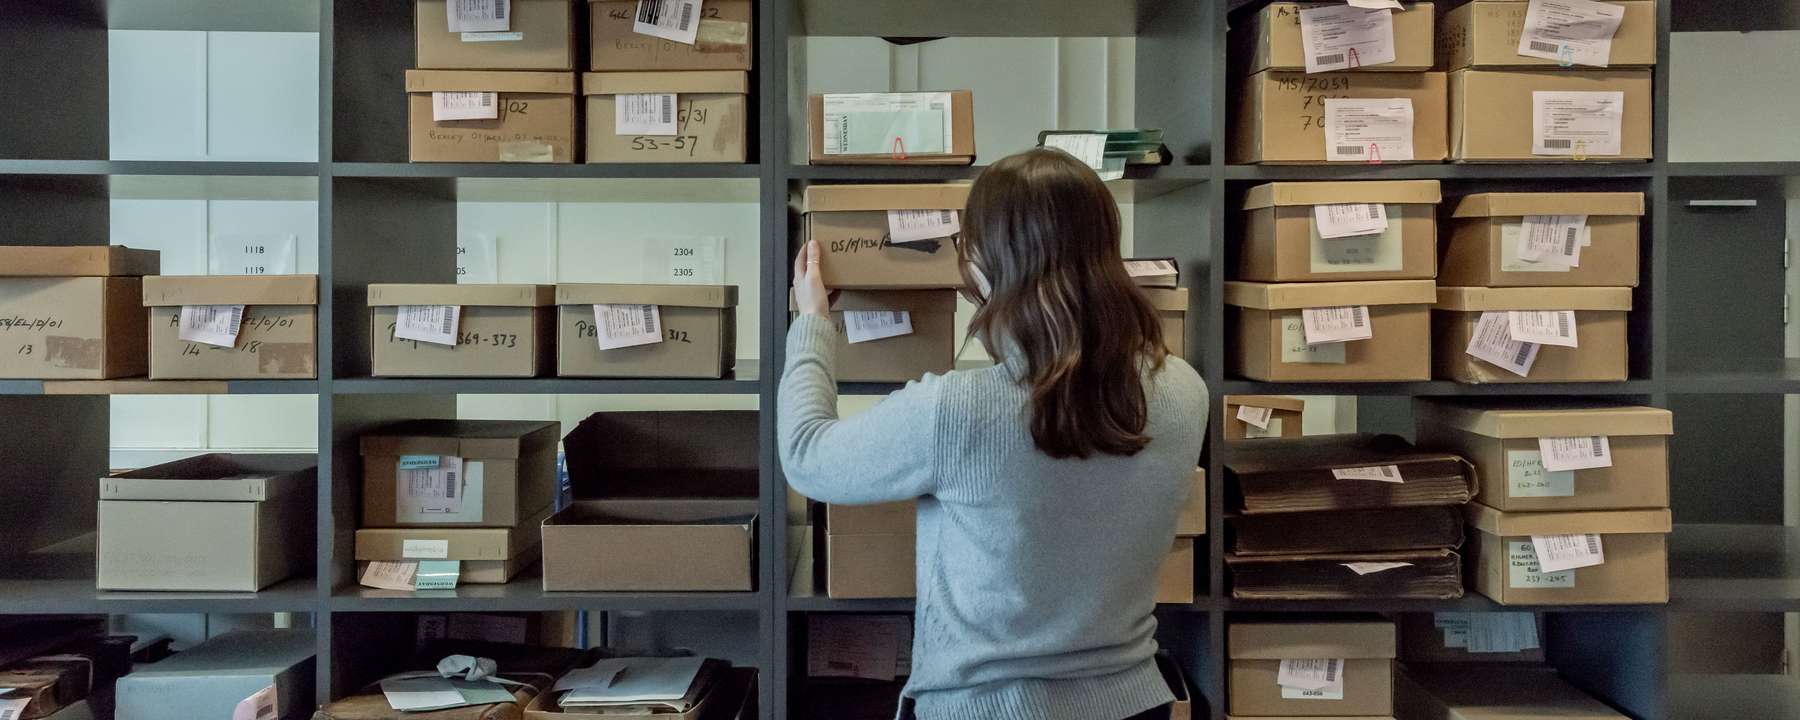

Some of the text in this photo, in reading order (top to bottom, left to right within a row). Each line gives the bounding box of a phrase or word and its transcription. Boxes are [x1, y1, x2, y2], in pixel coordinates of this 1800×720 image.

[245, 246, 265, 254] 1118
[674, 248, 694, 256] 2304
[245, 266, 265, 274] 1119
[674, 268, 694, 276] 2305
[668, 328, 691, 343] 312
[18, 344, 33, 355] 13
